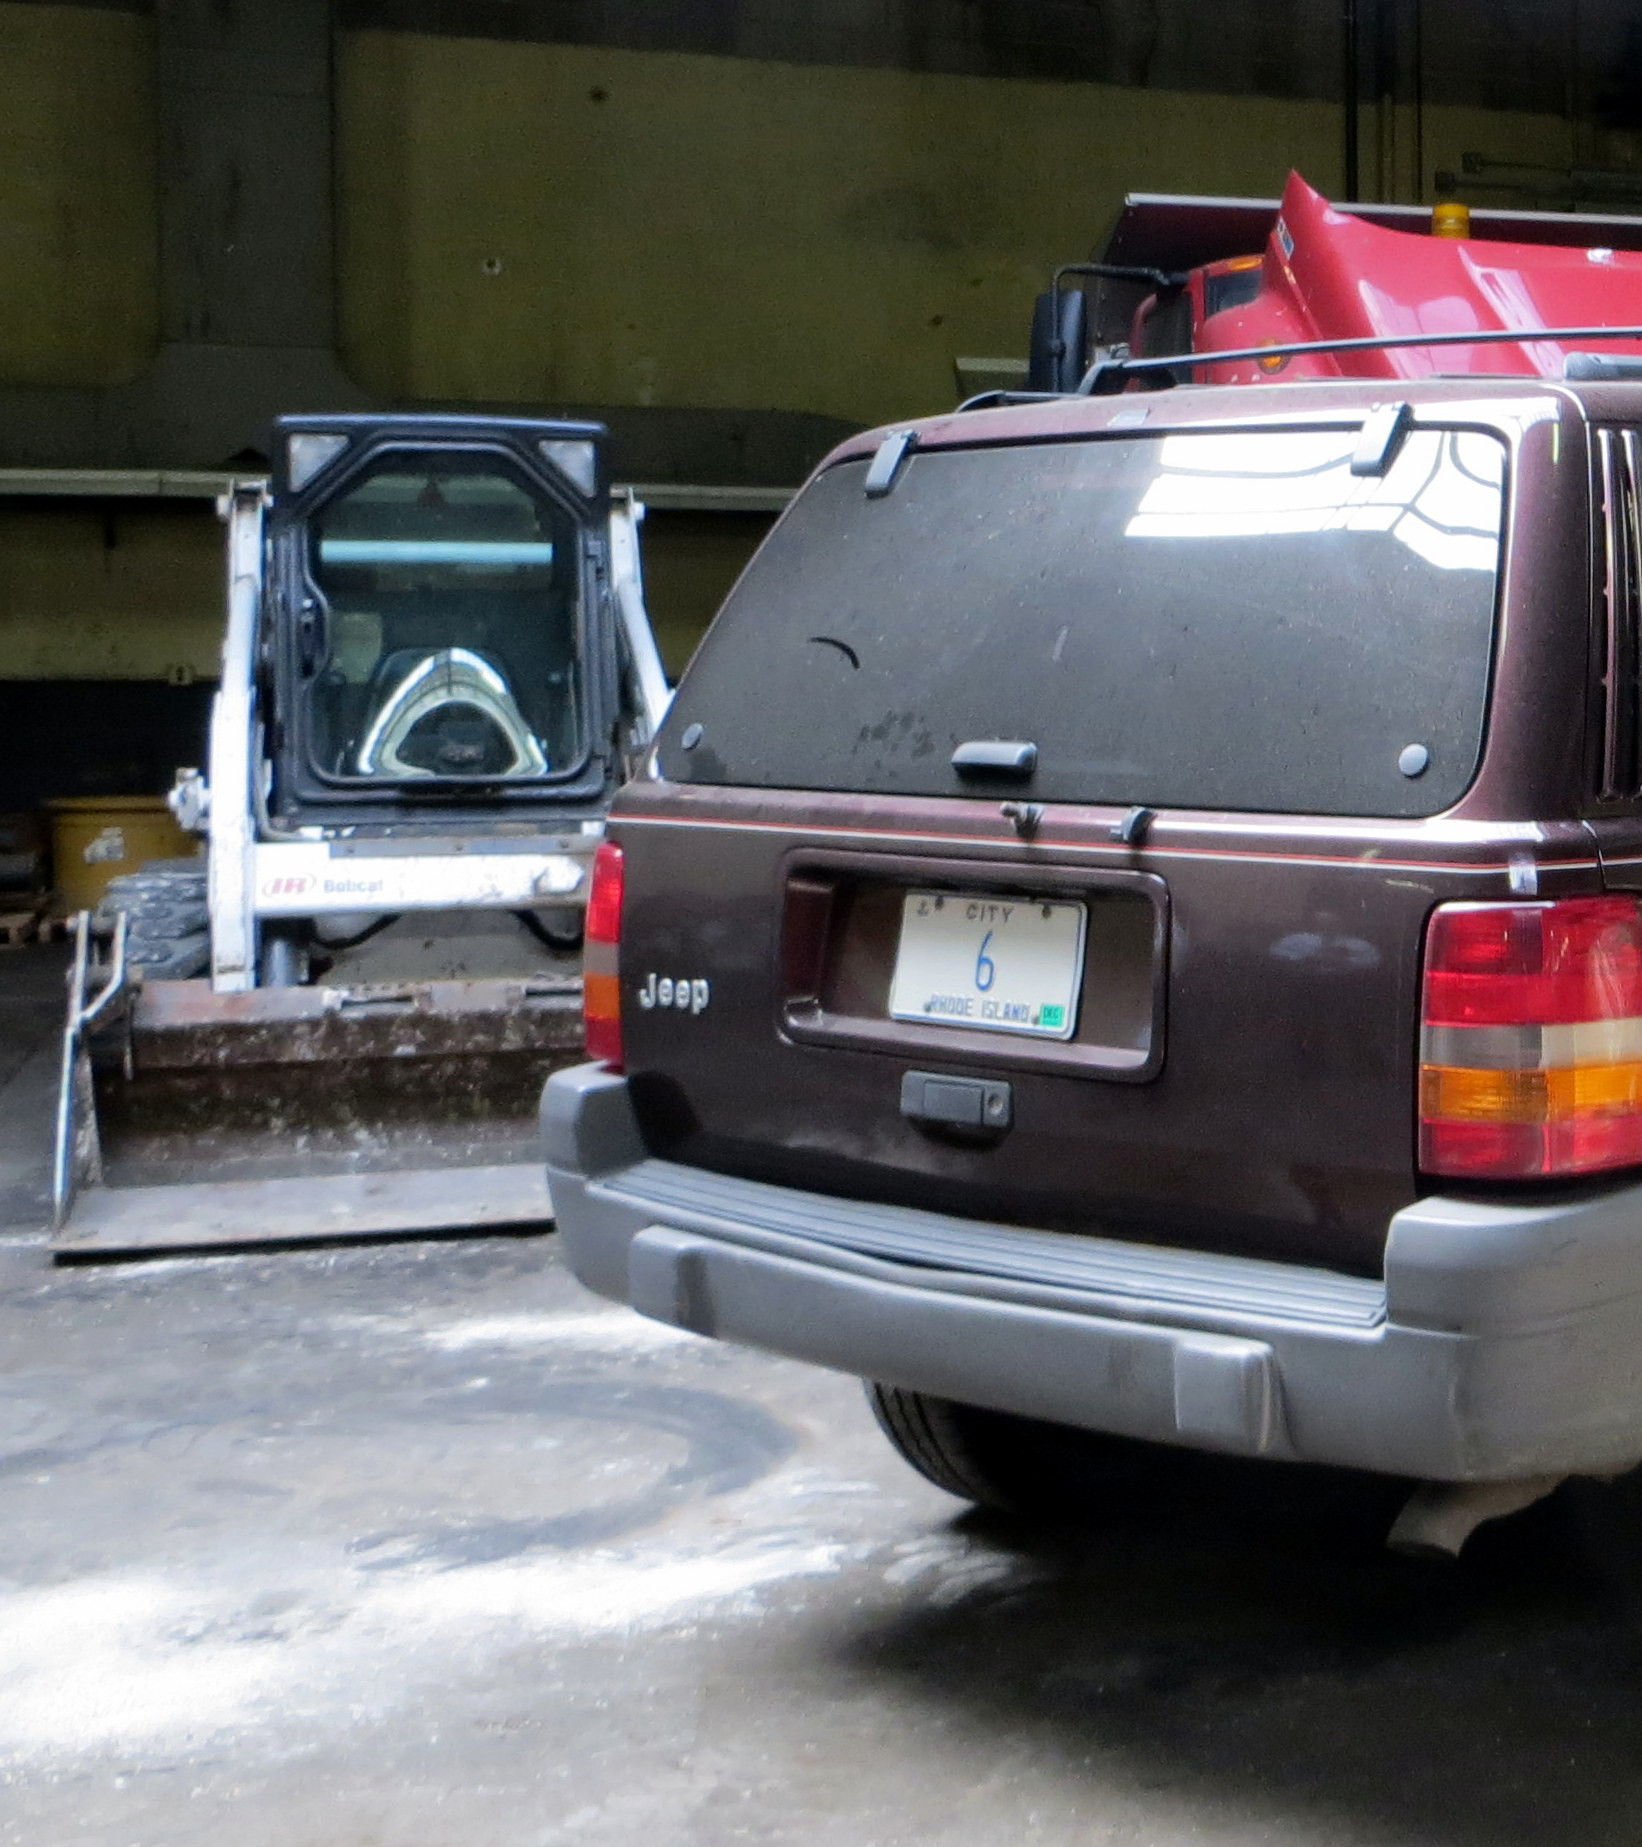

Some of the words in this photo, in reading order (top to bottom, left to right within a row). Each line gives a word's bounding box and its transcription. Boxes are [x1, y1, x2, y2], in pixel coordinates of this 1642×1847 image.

[323, 878, 384, 894] Bobcat
[966, 903, 1014, 923] CITY
[975, 930, 994, 991] 6
[639, 972, 710, 1016] Jeep
[929, 994, 974, 1017] RHODE
[981, 1002, 1030, 1024] ISLAND
